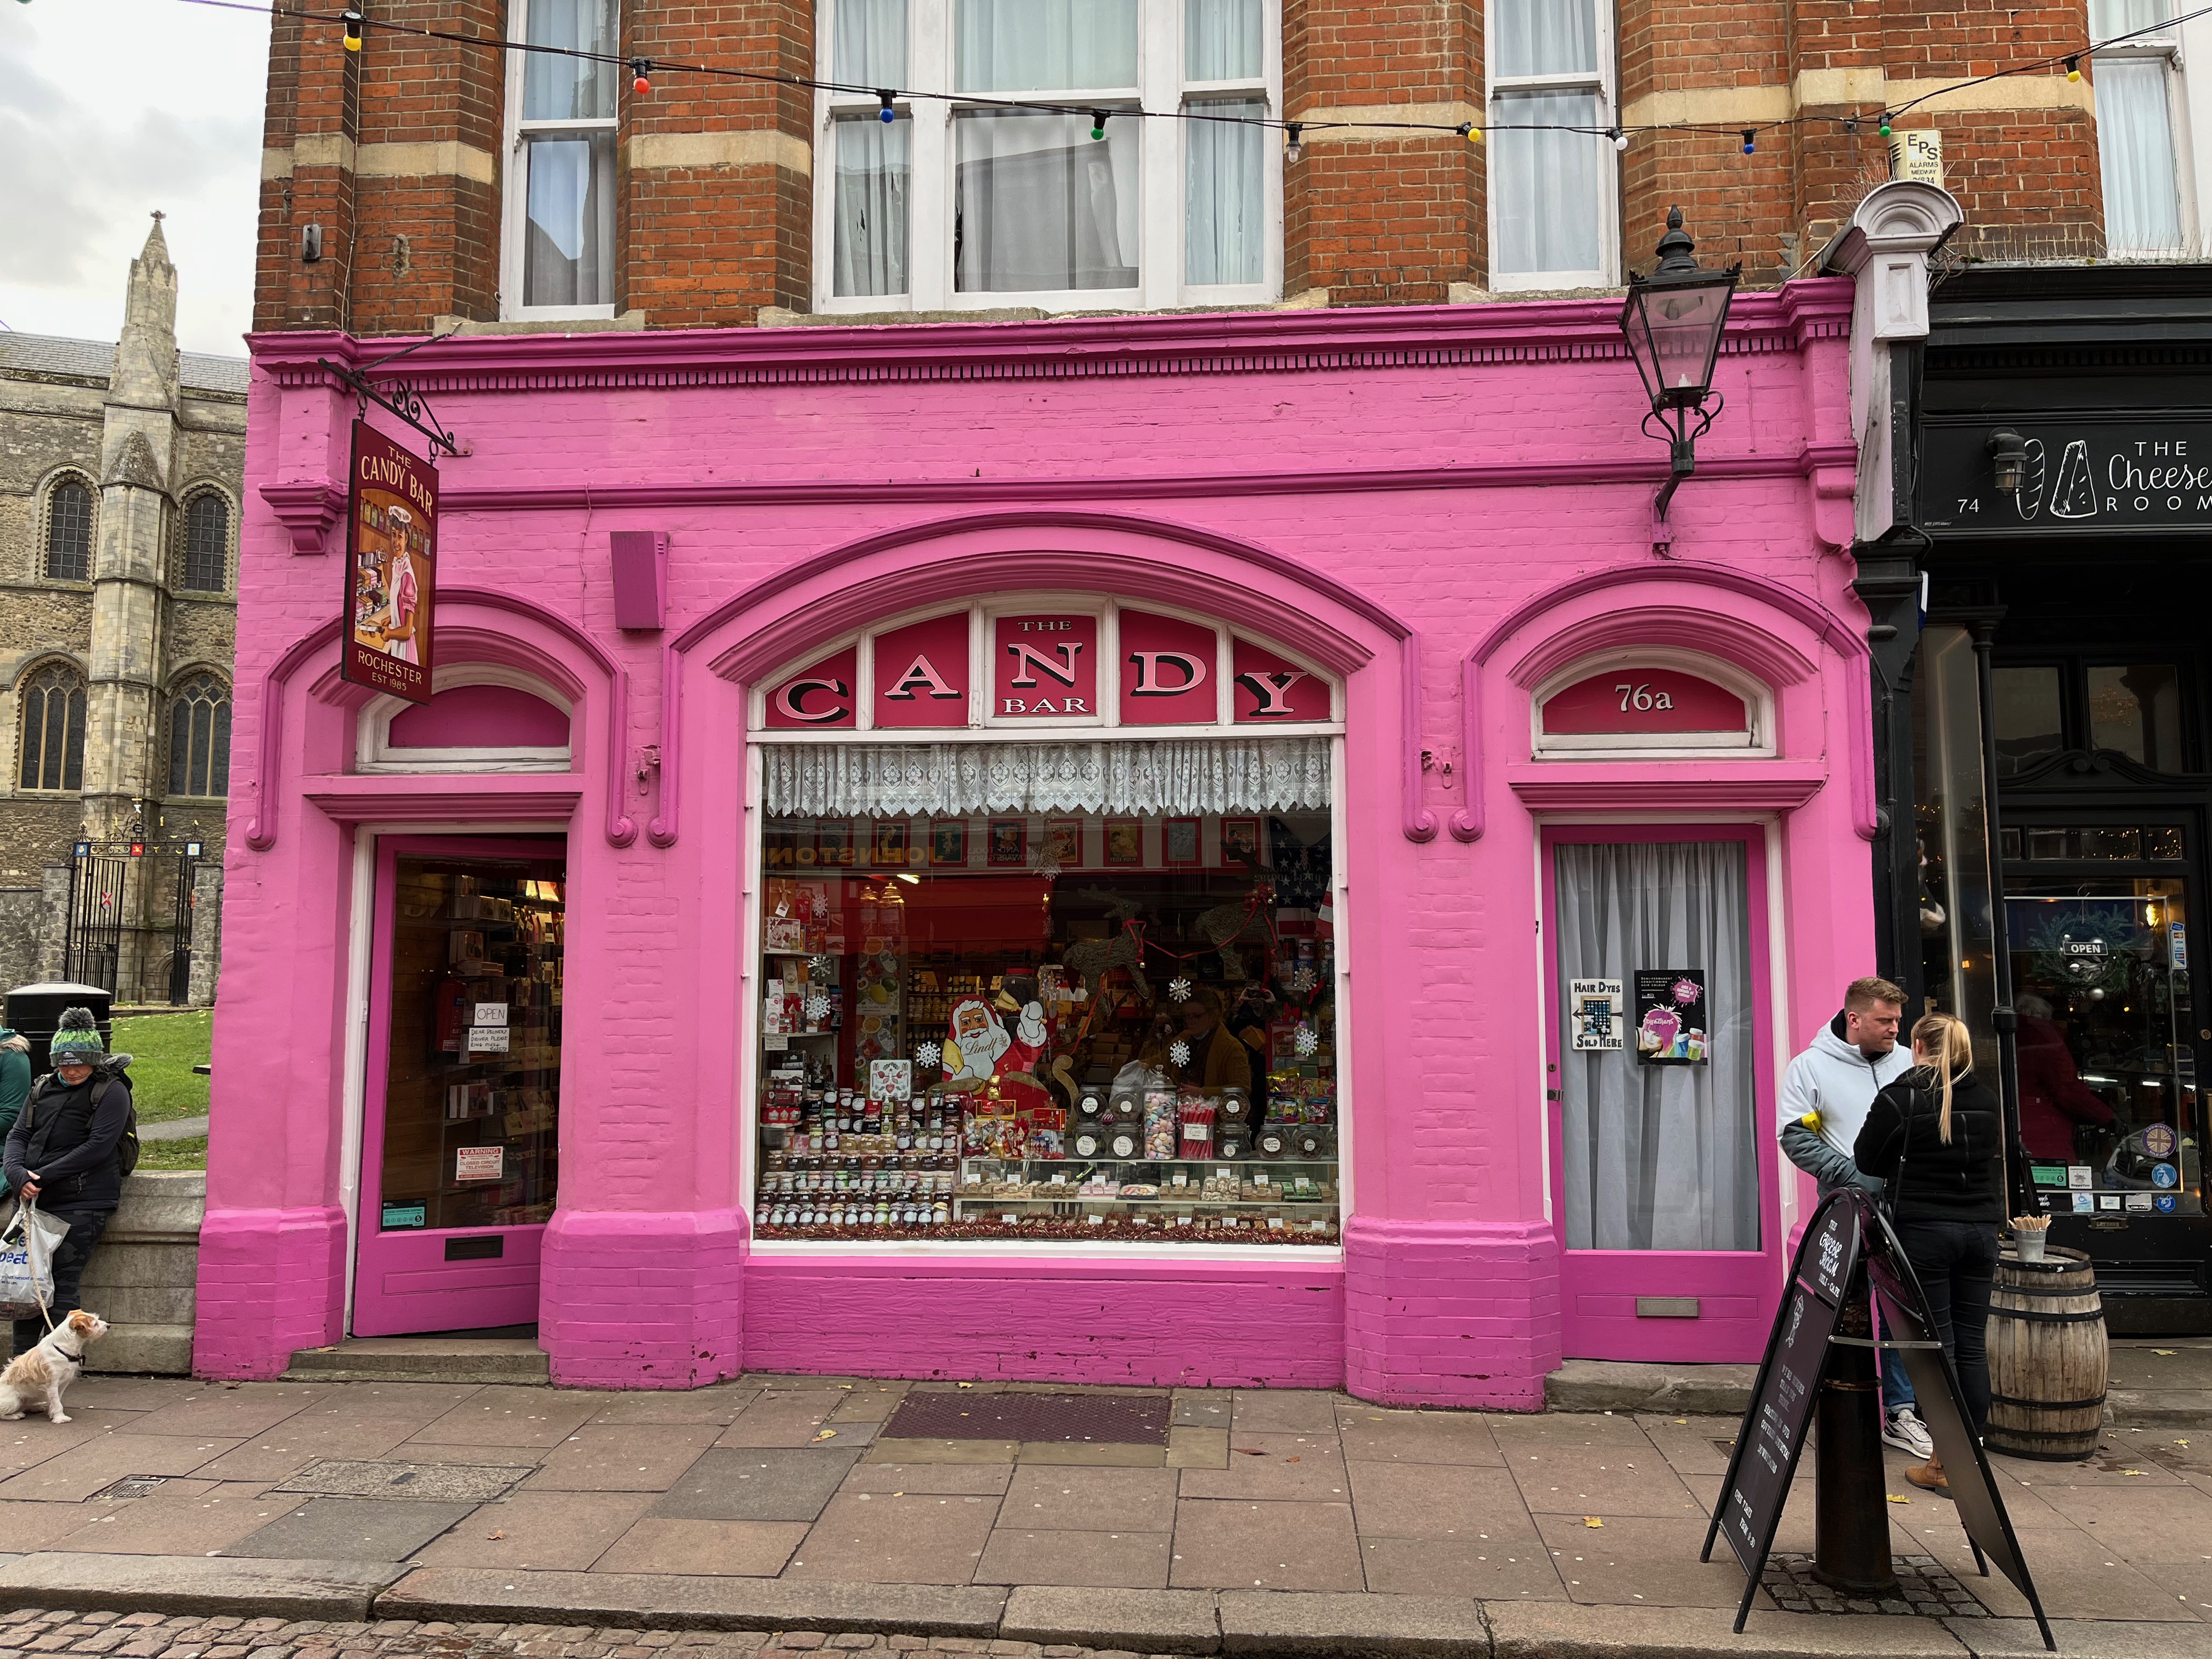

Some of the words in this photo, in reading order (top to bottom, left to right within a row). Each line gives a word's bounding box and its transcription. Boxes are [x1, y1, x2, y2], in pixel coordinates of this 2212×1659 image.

[1908, 134, 1938, 160] EPS
[2134, 441, 2187, 456] THE
[387, 445, 413, 469] THE
[2109, 454, 2212, 490] Cheese
[362, 455, 405, 489] CANDY
[410, 479, 432, 518] BAR
[1957, 499, 1980, 514] 74
[2106, 495, 2212, 511] ROOM
[1018, 620, 1073, 631] THE
[358, 650, 422, 685] ROCHESTER
[372, 672, 387, 685] EST
[390, 678, 408, 691] 1985
[1002, 697, 1090, 714] BAR
[1615, 684, 1674, 713] 76a
[2070, 944, 2101, 953] OPEN
[1574, 982, 1596, 993] HAIR
[1599, 981, 1621, 993] DYES
[476, 1008, 505, 1020] OPEN
[963, 1037, 998, 1056] Lindt
[1576, 1034, 1598, 1048] SOLD
[1599, 1034, 1622, 1048] HERE
[1829, 1219, 1838, 1232] THE
[1819, 1232, 1843, 1259] CHEESE
[1734, 1488, 1743, 1504] OPEN
